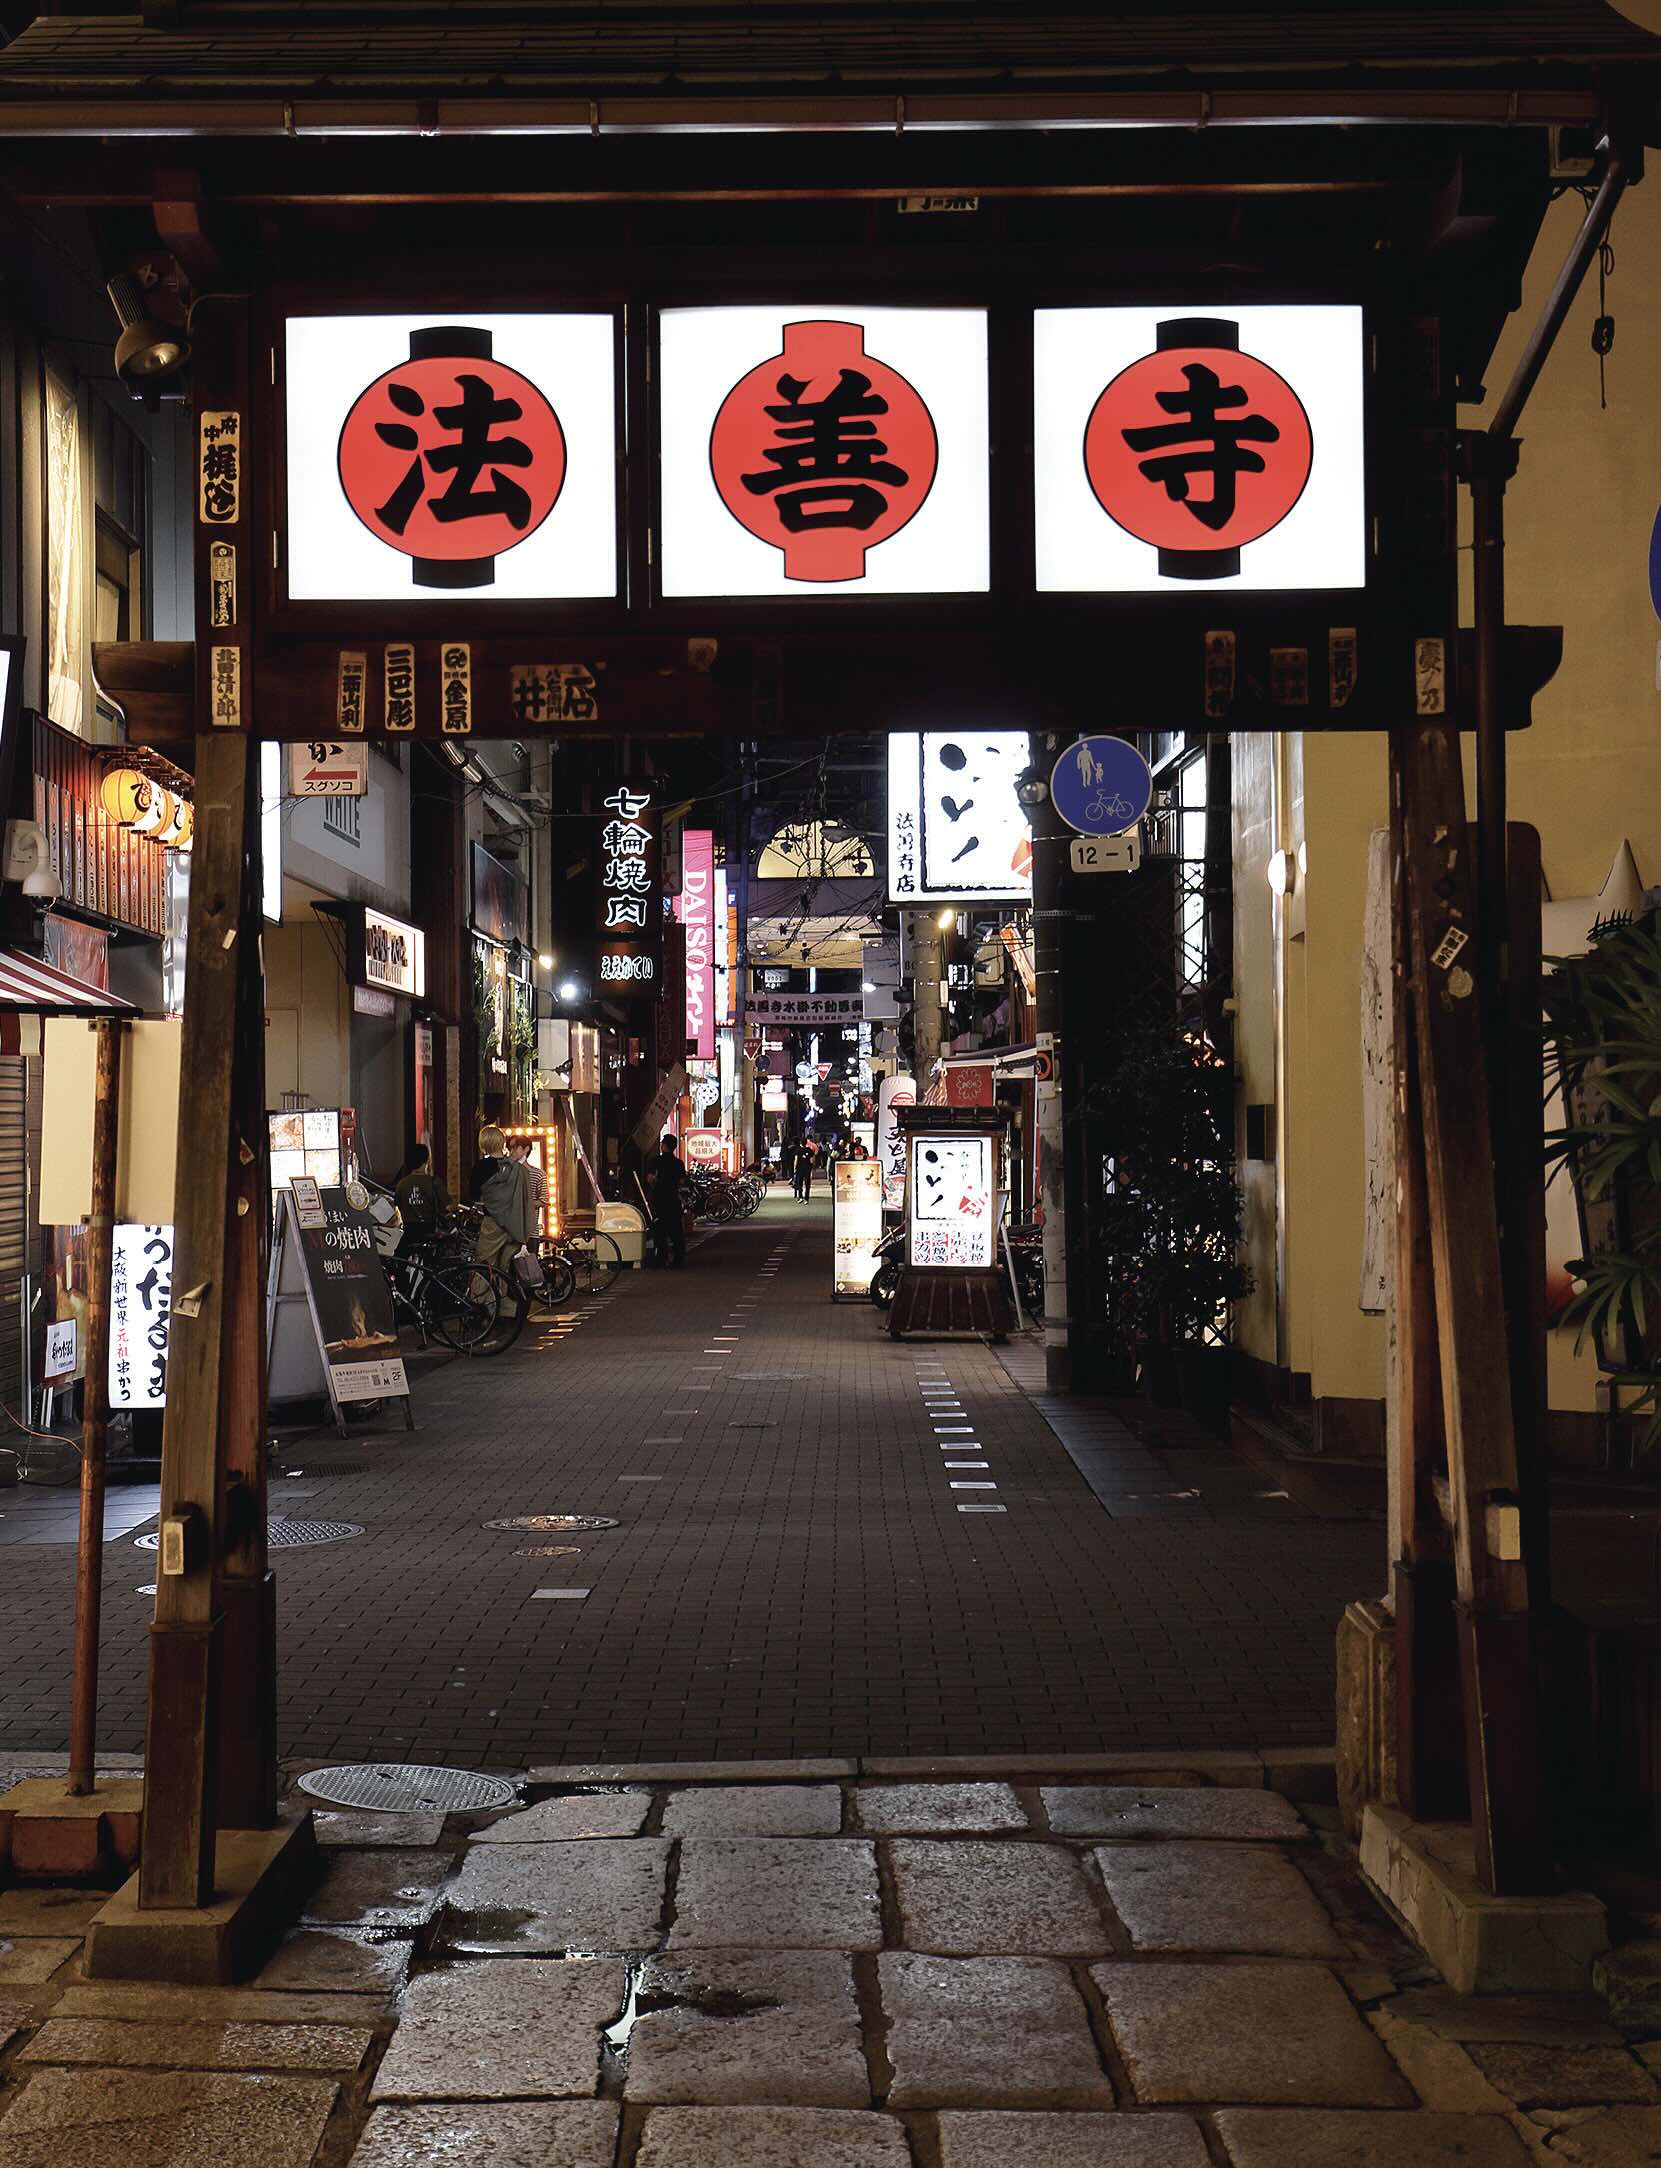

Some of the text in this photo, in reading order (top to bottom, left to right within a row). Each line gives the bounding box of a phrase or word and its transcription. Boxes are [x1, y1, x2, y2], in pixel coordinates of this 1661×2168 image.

[375, 364, 1279, 535] 法 善 寺
[305, 781, 353, 792] スグソコ
[603, 786, 653, 927] 七輪焼肉
[685, 870, 707, 972] DAISO
[112, 1246, 131, 1401] 大阪新世界元祖串かつ
[136, 1226, 171, 1398] つだるま
